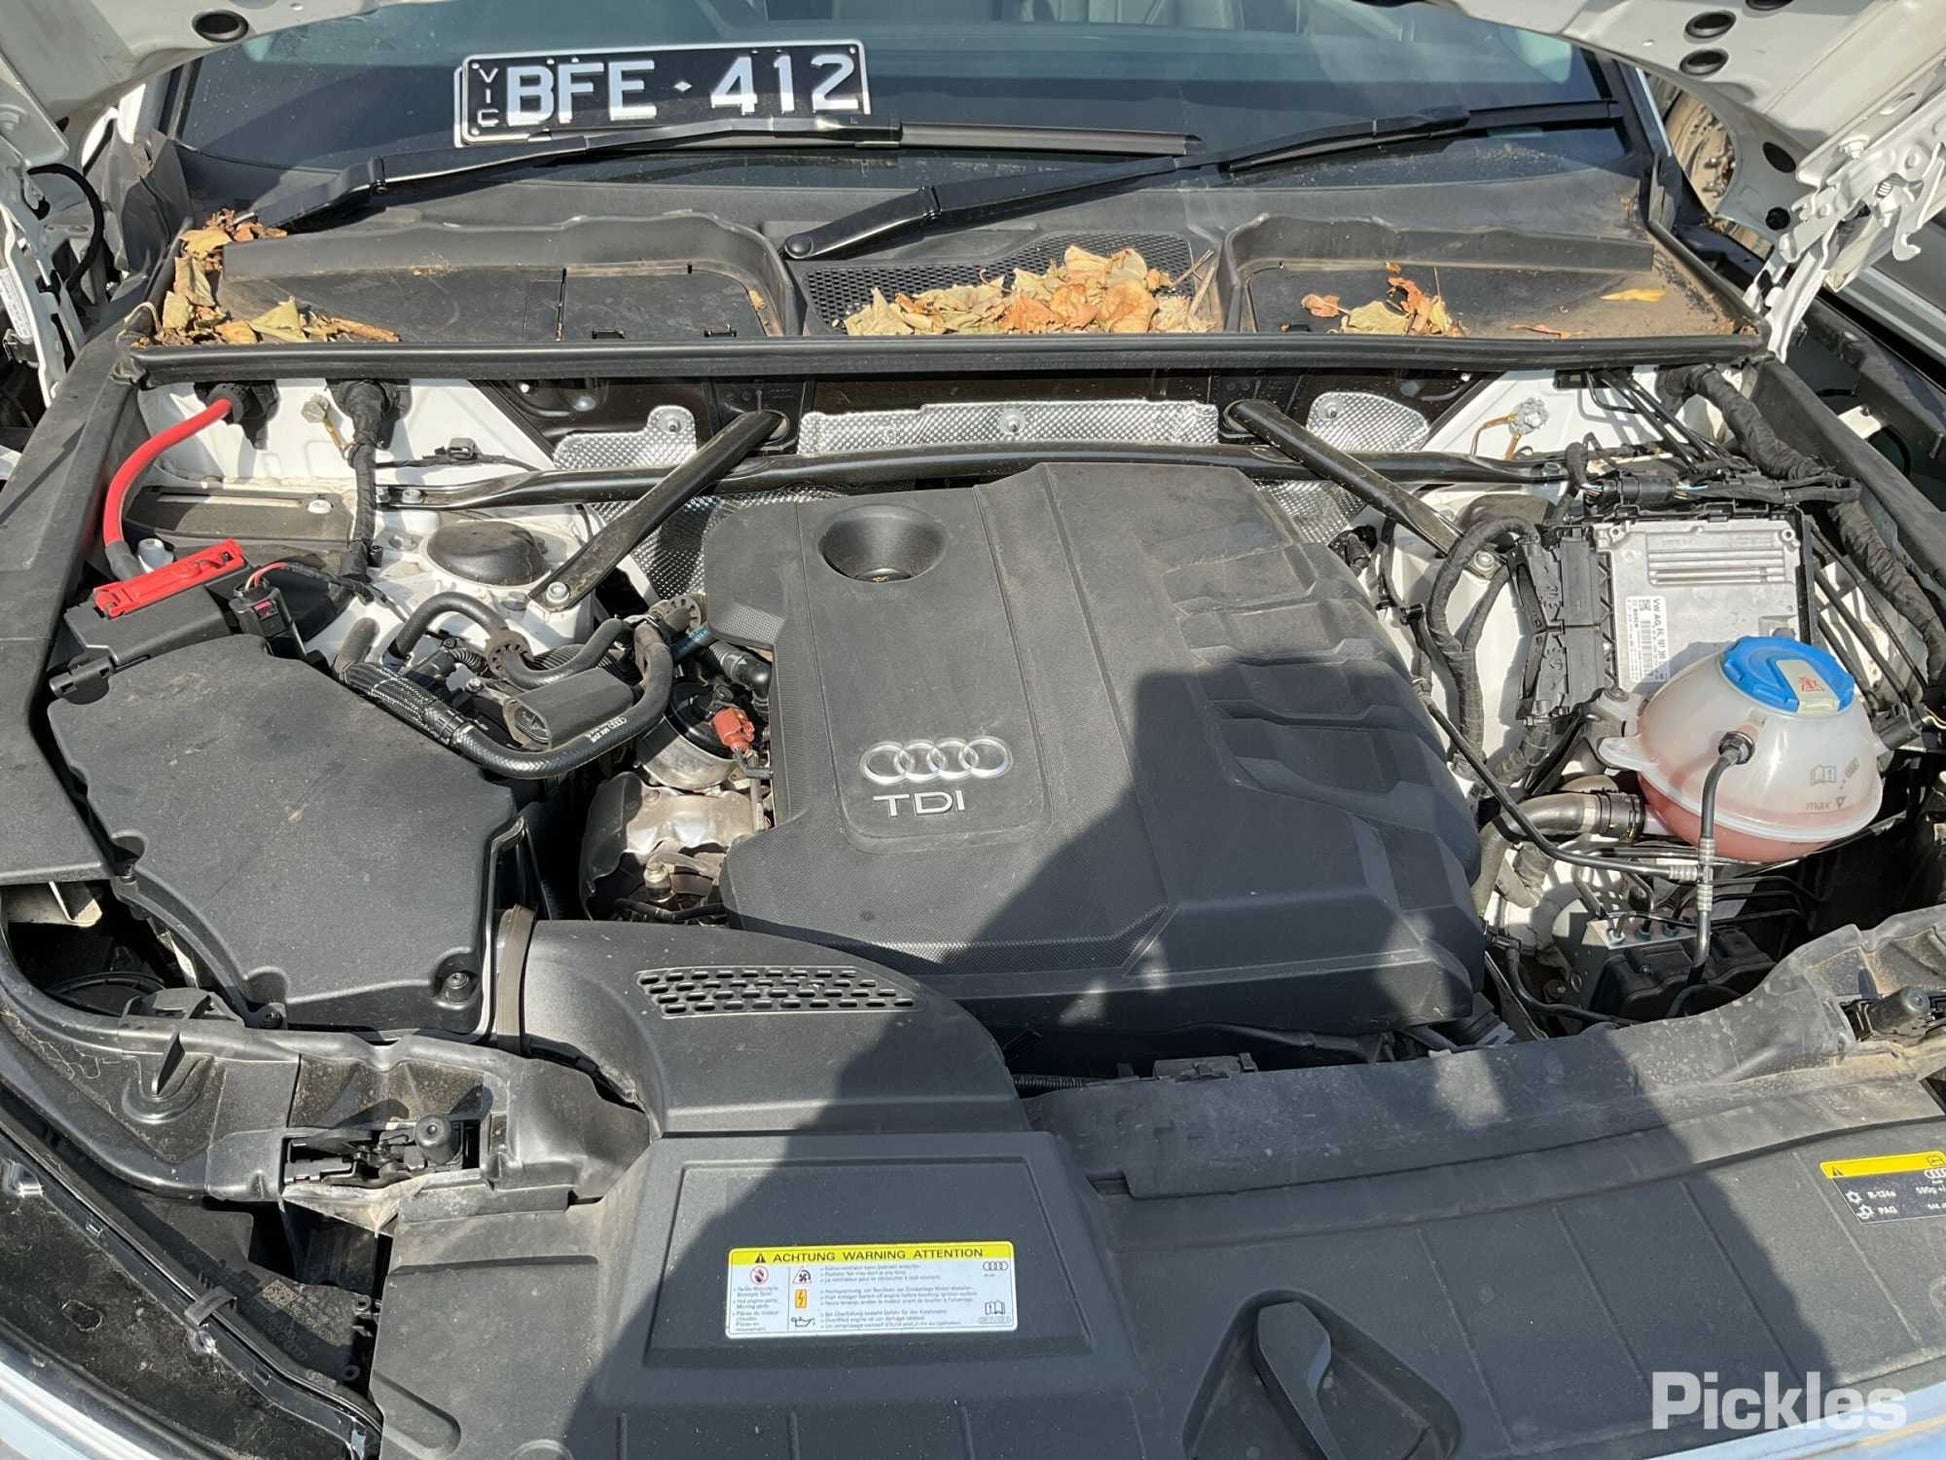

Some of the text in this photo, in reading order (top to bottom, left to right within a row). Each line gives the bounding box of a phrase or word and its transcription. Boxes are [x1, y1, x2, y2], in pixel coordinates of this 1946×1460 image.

[476, 66, 500, 127] VIC
[505, 54, 860, 127] BFE 412
[873, 790, 966, 819] TDI
[773, 1247, 984, 1264] ACHTUNG WARNING ATTENTION
